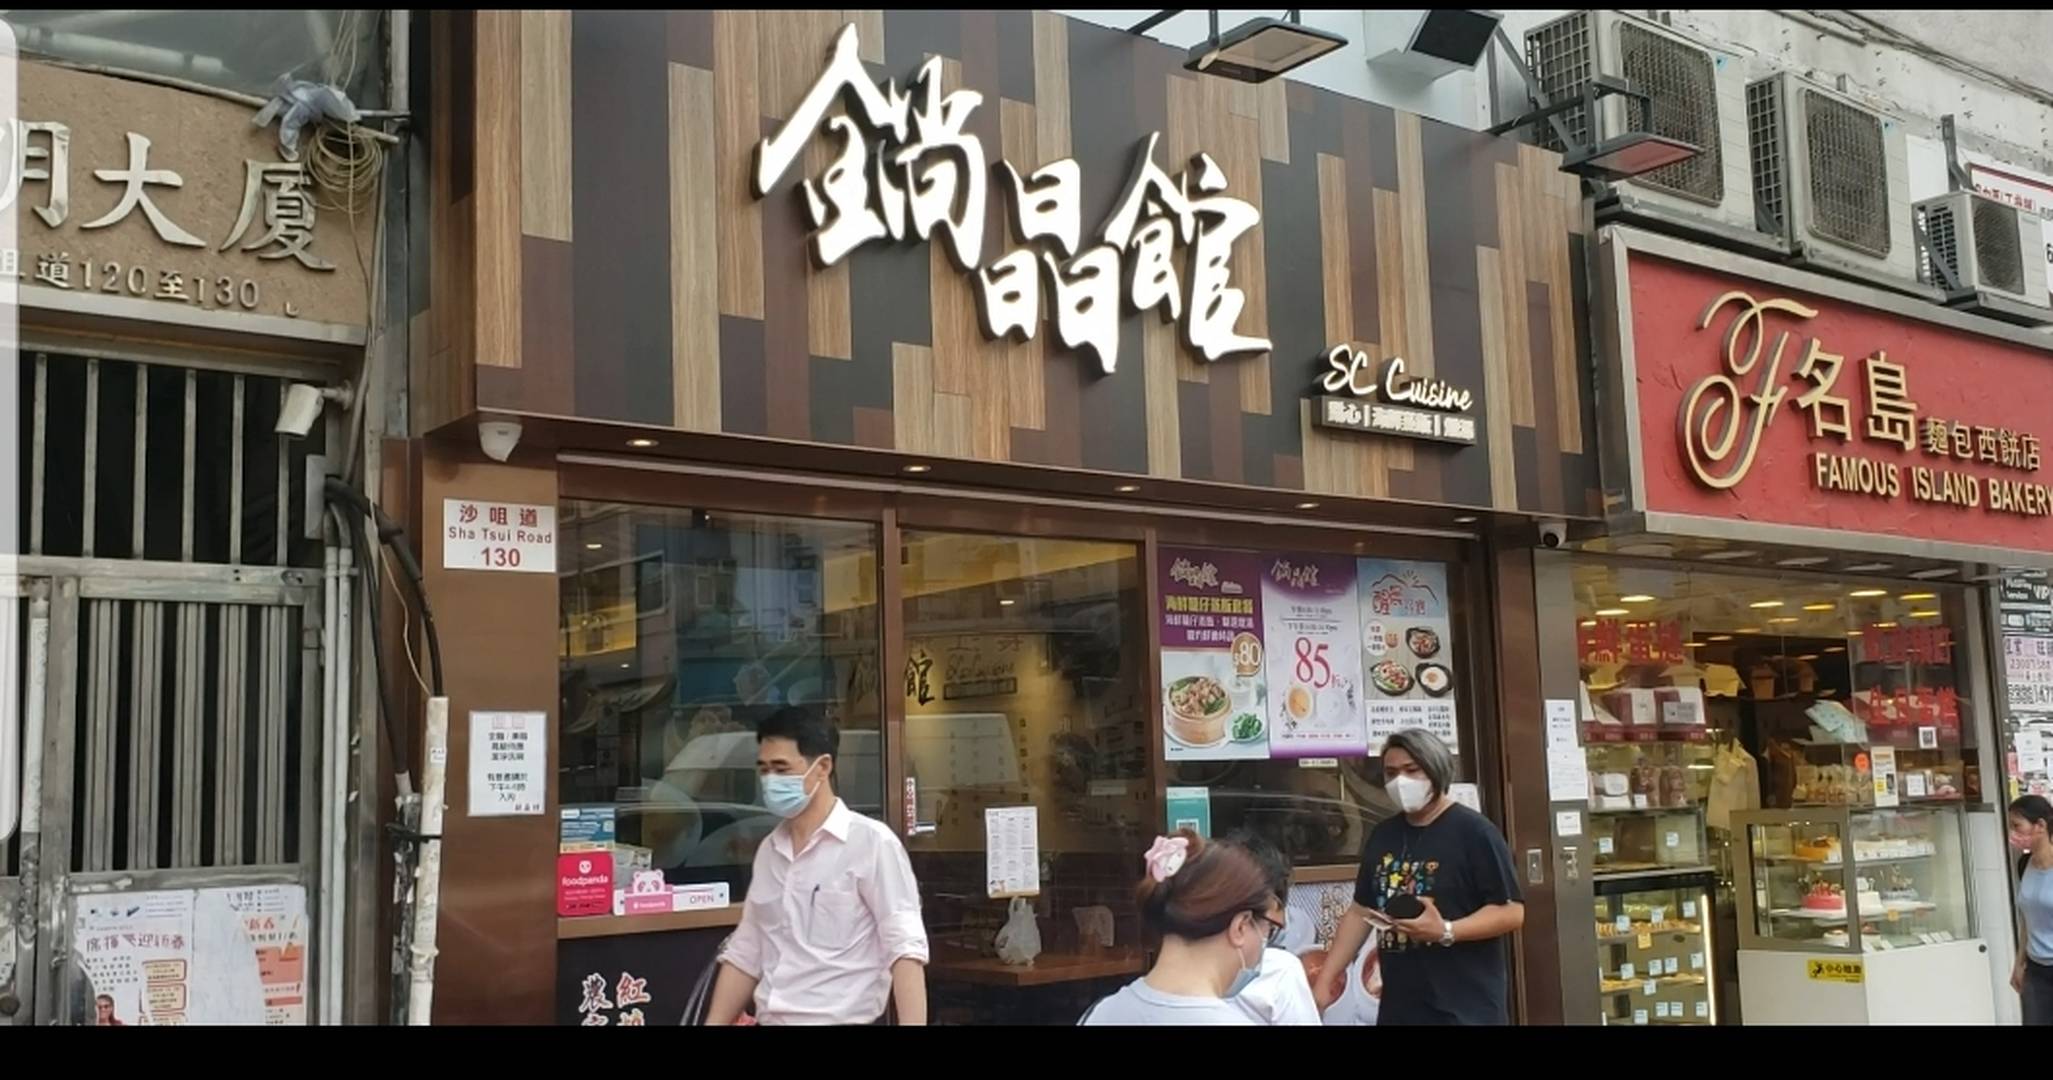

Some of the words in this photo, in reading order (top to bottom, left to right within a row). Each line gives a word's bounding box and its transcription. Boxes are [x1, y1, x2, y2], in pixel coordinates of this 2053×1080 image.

[1323, 343, 1378, 396] SC
[1385, 356, 1473, 412] Cuisine
[1796, 337, 1918, 451] 名島
[1815, 452, 1900, 498] FAMOUS
[1911, 466, 1979, 508] ISLAND
[459, 503, 538, 528] 沙咀道
[448, 525, 476, 540] Sha
[481, 527, 511, 542] Tsui
[516, 529, 552, 544] Road
[480, 546, 521, 567] 130
[561, 874, 609, 887] foodpanda
[689, 893, 715, 905] OPEN
